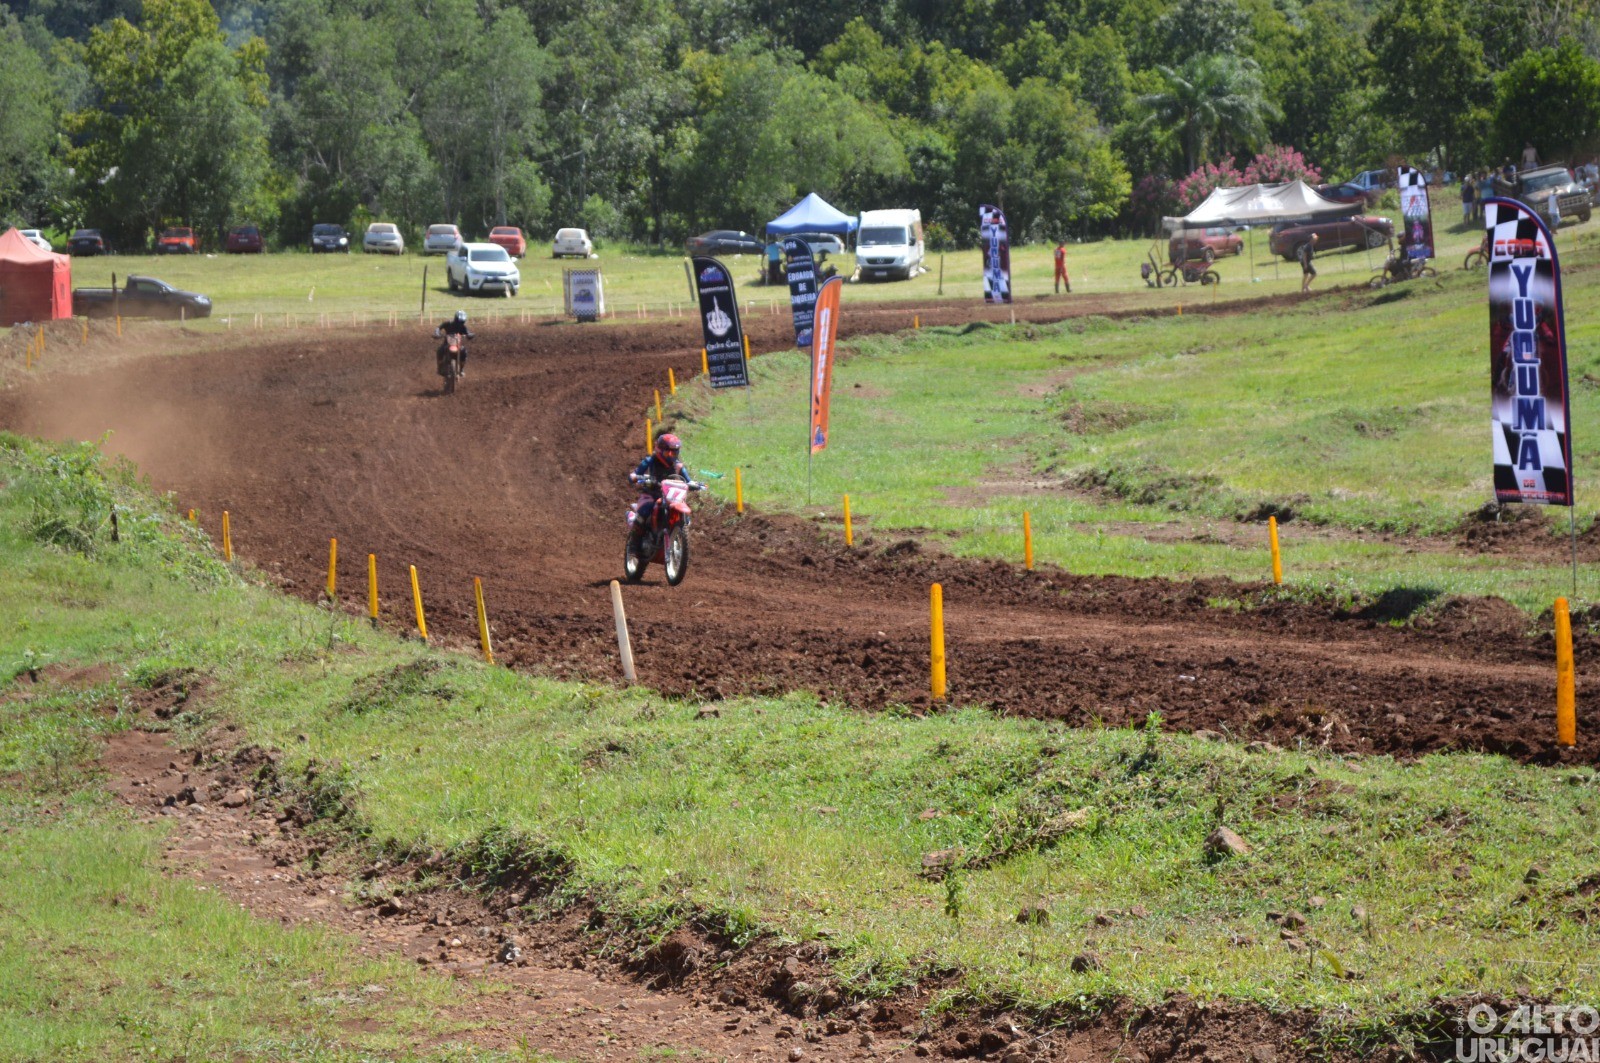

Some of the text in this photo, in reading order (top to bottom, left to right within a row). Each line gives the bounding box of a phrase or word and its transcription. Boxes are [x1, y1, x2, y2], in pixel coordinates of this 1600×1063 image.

[1494, 238, 1545, 257] COPA
[798, 282, 807, 291] DE
[791, 292, 816, 304] SIQUEIRA
[1510, 264, 1545, 471] YUCUMÃ
